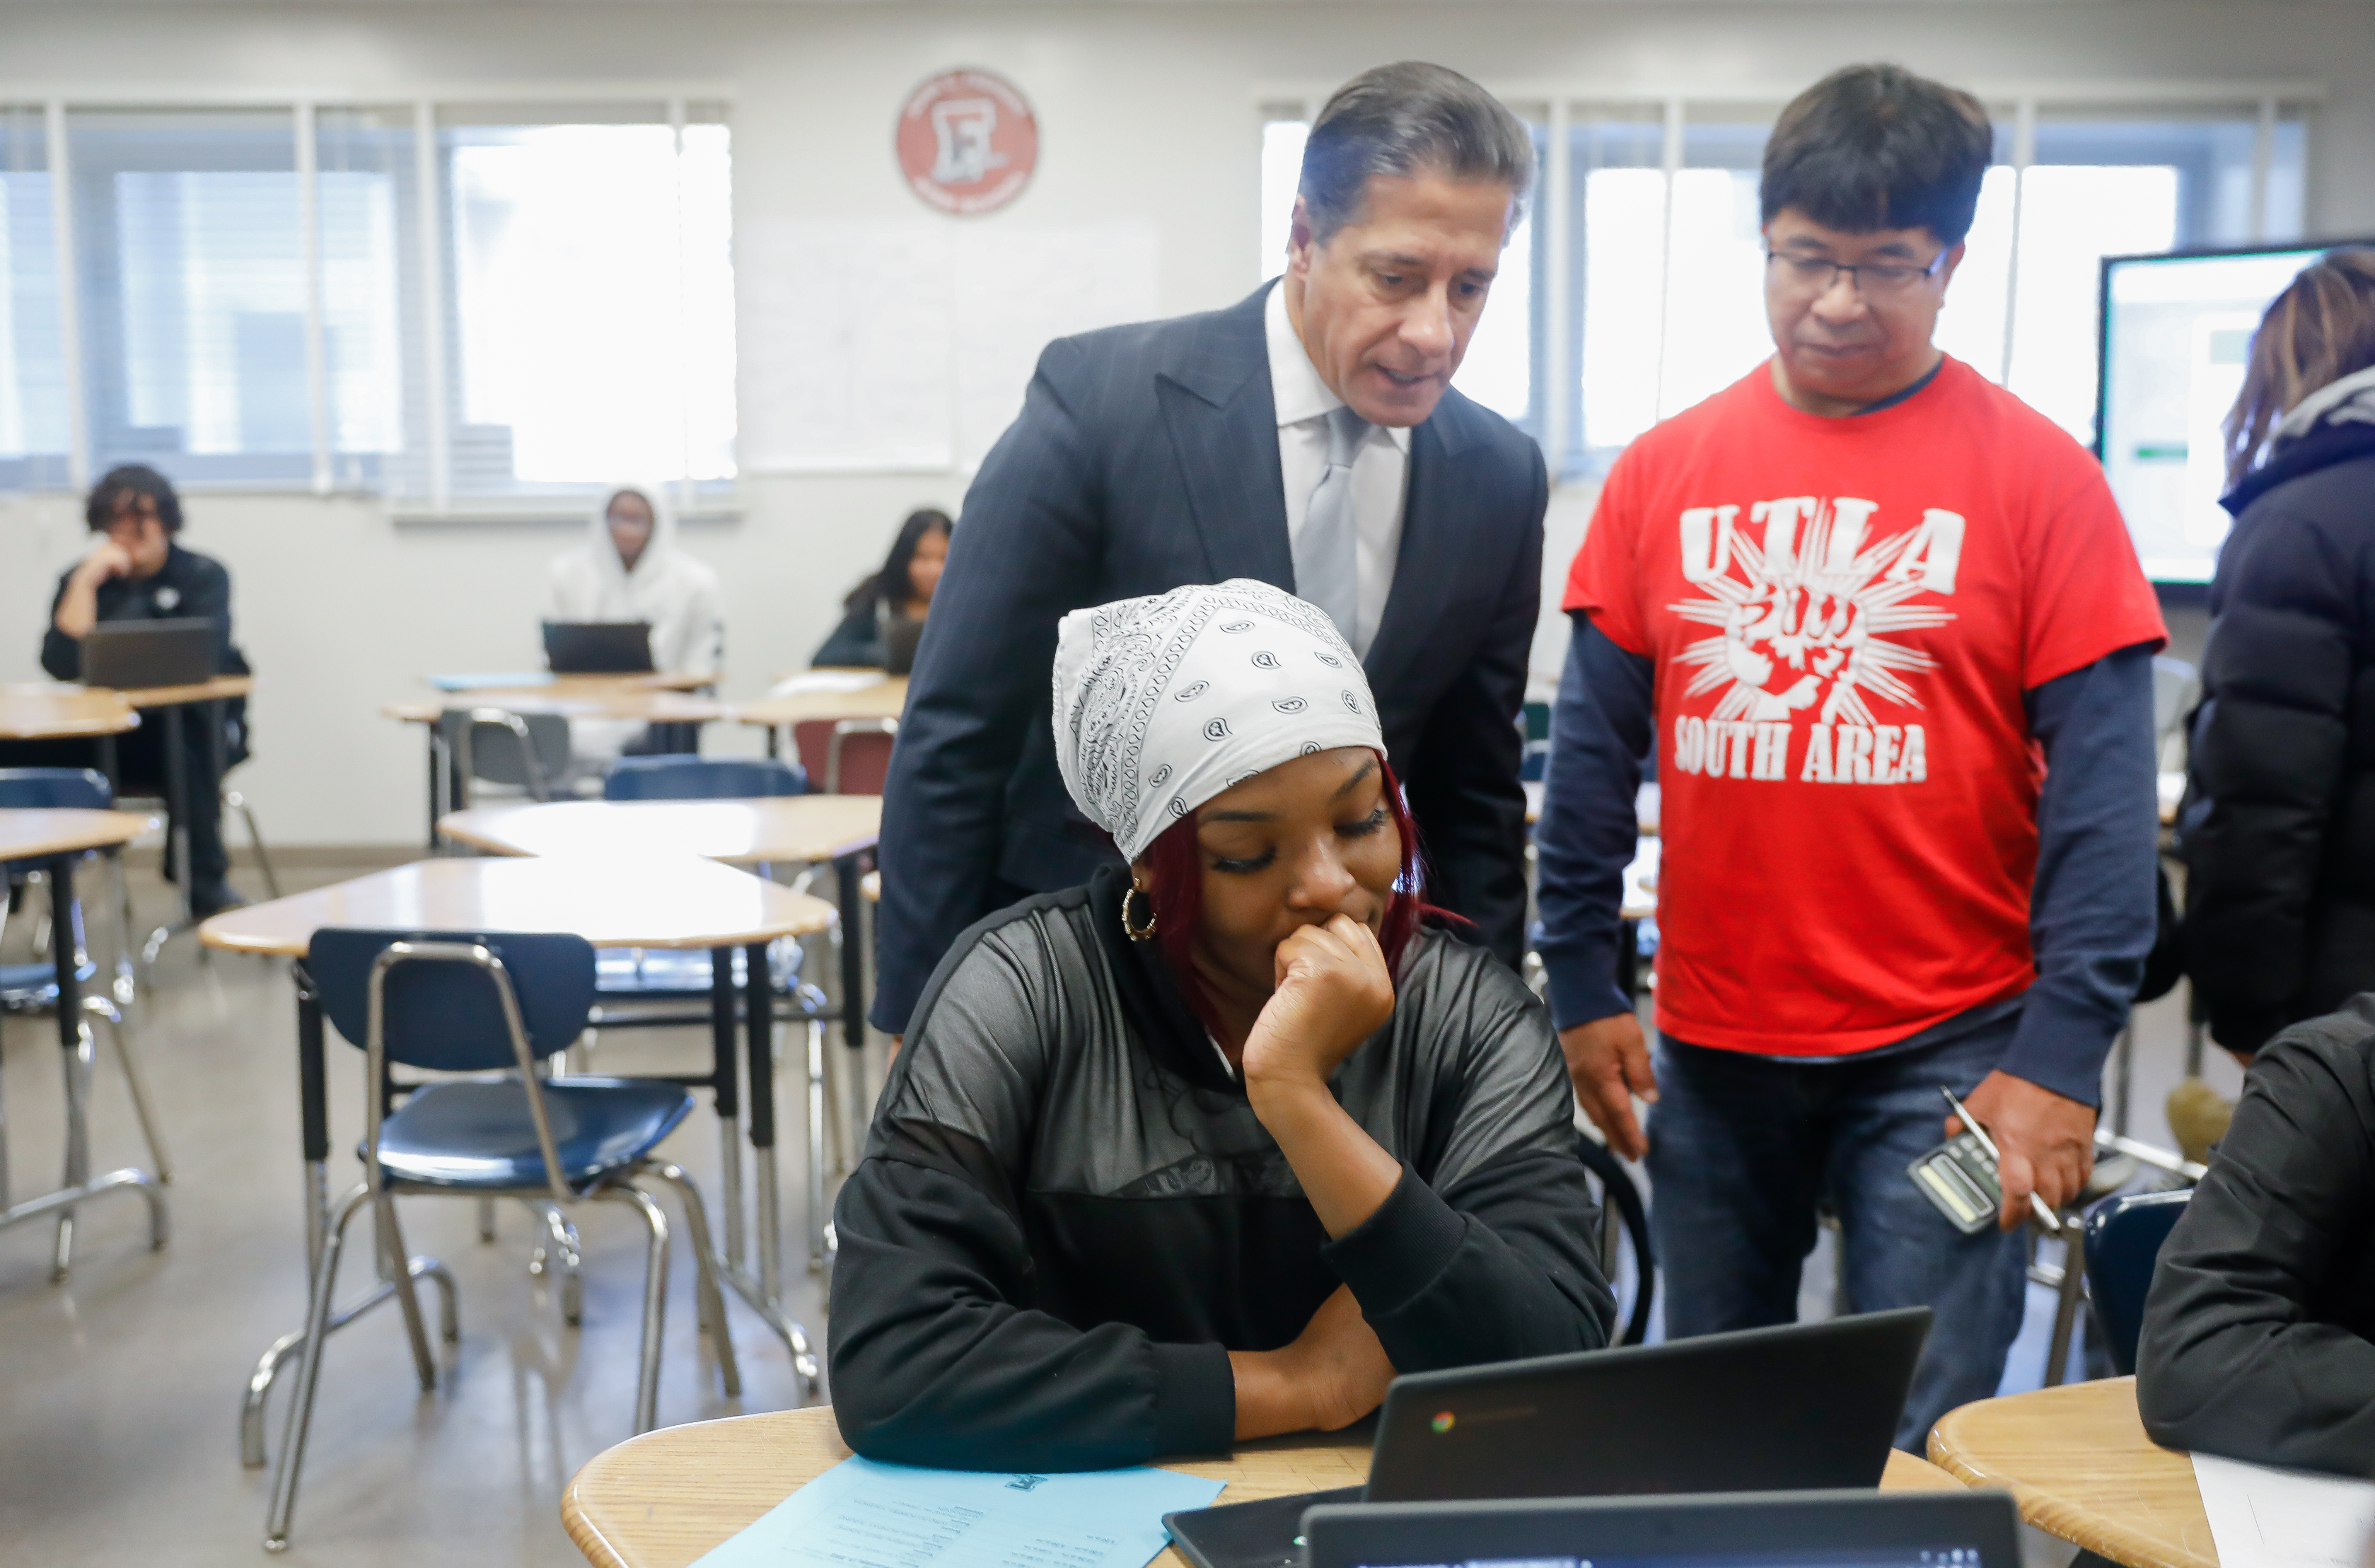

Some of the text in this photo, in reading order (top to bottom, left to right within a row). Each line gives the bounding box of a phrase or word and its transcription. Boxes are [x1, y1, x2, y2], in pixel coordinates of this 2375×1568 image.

[1680, 496, 1965, 595] UTLA
[1674, 715, 1927, 784] SOUTH AREA
